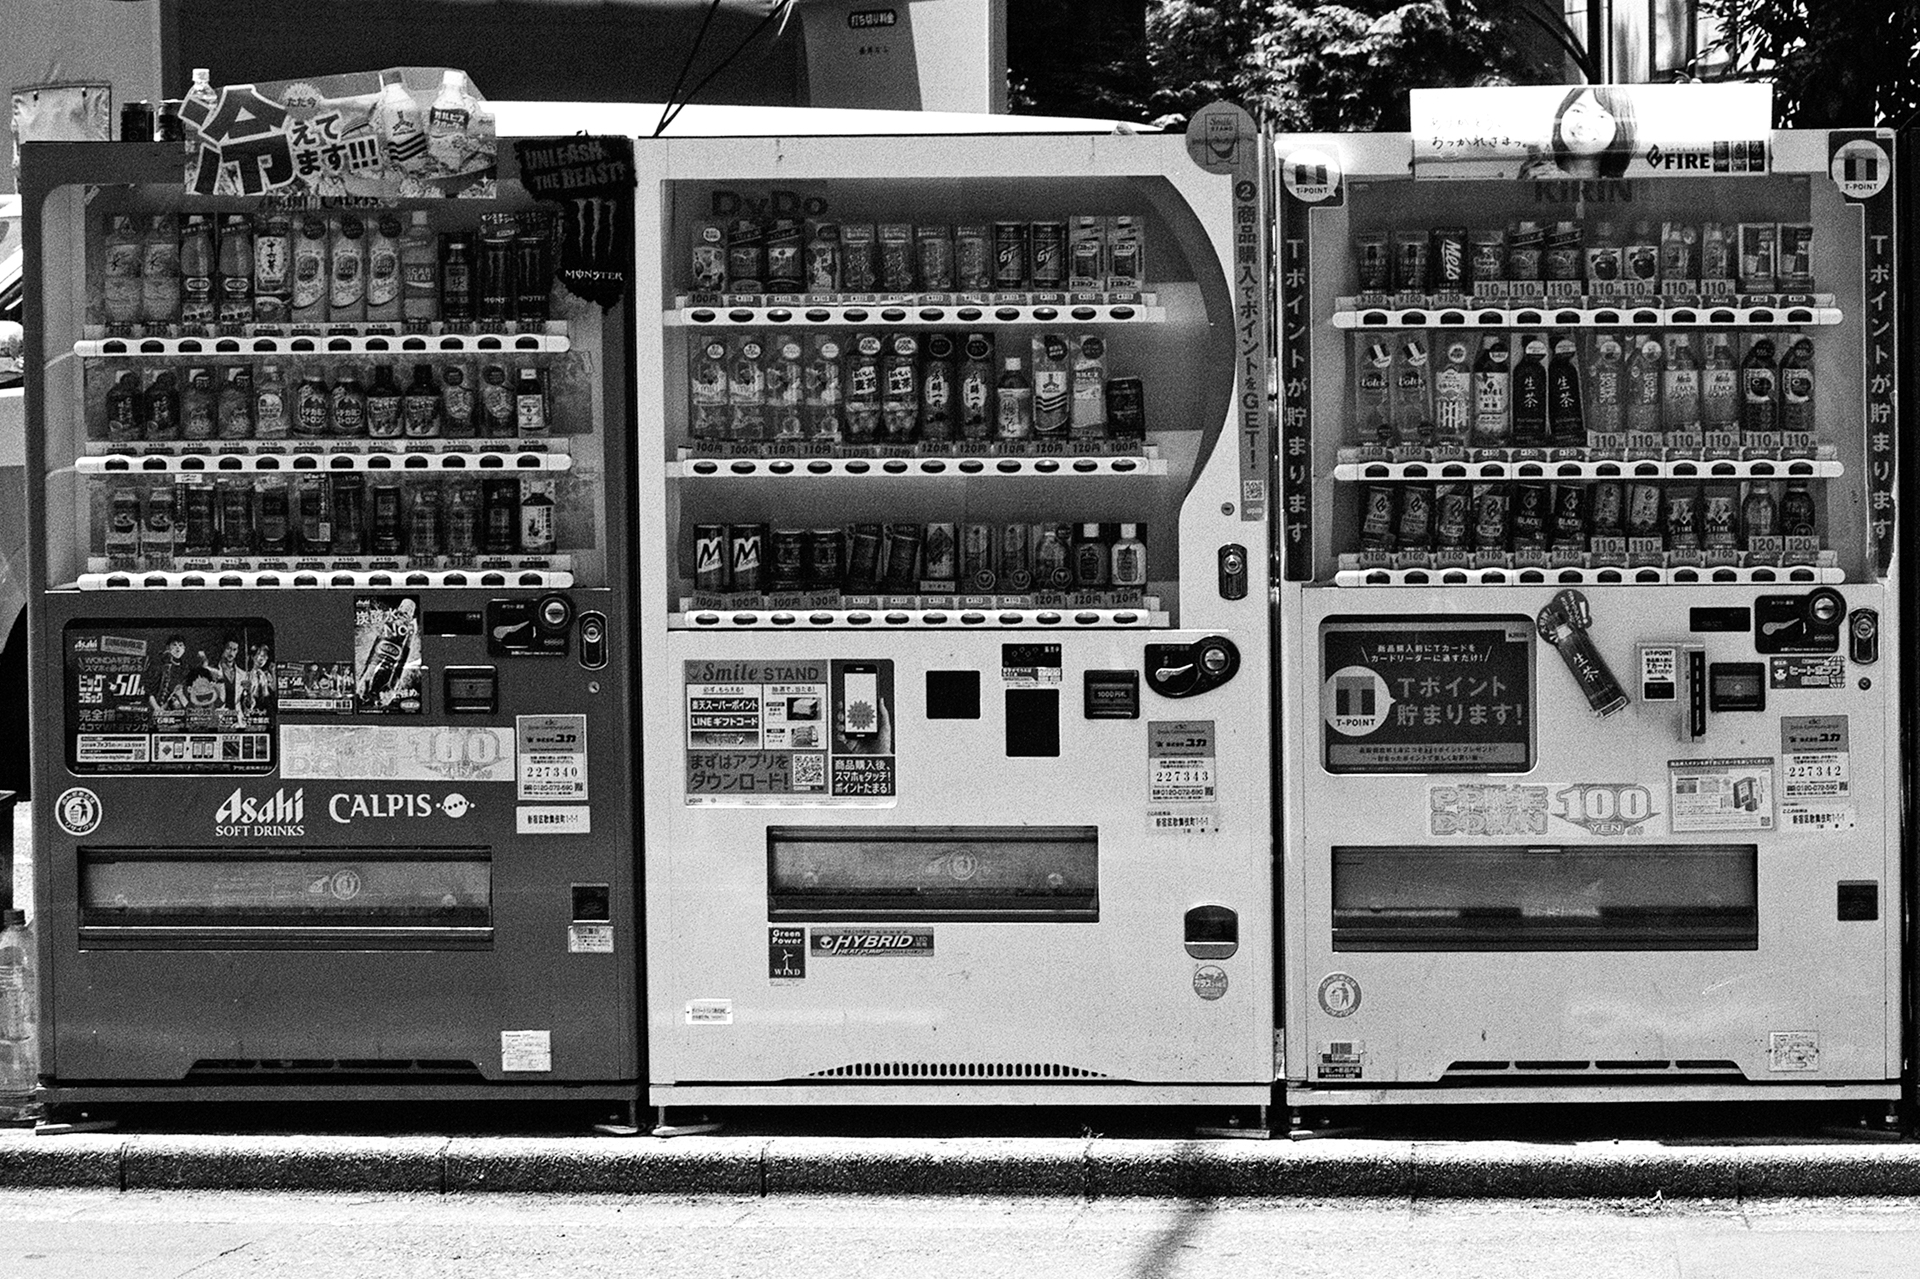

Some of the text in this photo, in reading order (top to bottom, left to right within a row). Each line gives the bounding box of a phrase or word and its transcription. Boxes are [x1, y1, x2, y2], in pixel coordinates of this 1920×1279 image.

[292, 112, 342, 146] えて
[1664, 153, 1711, 170] FIRE
[533, 173, 560, 191] THE
[1844, 183, 1878, 191] T-POINT
[1295, 187, 1328, 195] T-POINT
[564, 268, 623, 281] MONSTER
[1286, 239, 1309, 543] Tポイントが貯まります
[1523, 376, 1539, 408] 生茶
[1557, 376, 1574, 408] 生茶
[1870, 235, 1891, 540] Tポイントが貯まります
[703, 663, 819, 682] Smile STAND
[1397, 675, 1506, 698] Tポイント
[691, 699, 758, 711] 楽天スーパーポイント
[1397, 703, 1523, 726] 貯まります!
[691, 716, 759, 727] LINE ギフトコード
[1336, 718, 1376, 727] T-POINT
[690, 753, 789, 770] まずはアプリを
[834, 760, 891, 771] 商品購入後、
[526, 766, 578, 778] 227340
[834, 771, 891, 782] スマホをタッチ!
[1156, 771, 1209, 783] 227343
[1788, 765, 1842, 778] 227342
[690, 772, 789, 791] ダウンロード!
[834, 783, 892, 795] ポイントたまる!
[215, 787, 305, 825] Asahi
[329, 793, 432, 824] CALPIS
[1556, 786, 1652, 822] 100
[215, 826, 305, 838] SOFT DRINKS
[1589, 823, 1624, 833] YEN
[772, 929, 801, 937] Green
[772, 937, 802, 945] Power
[832, 935, 914, 954] HYBRID
[774, 968, 802, 976] WIND
